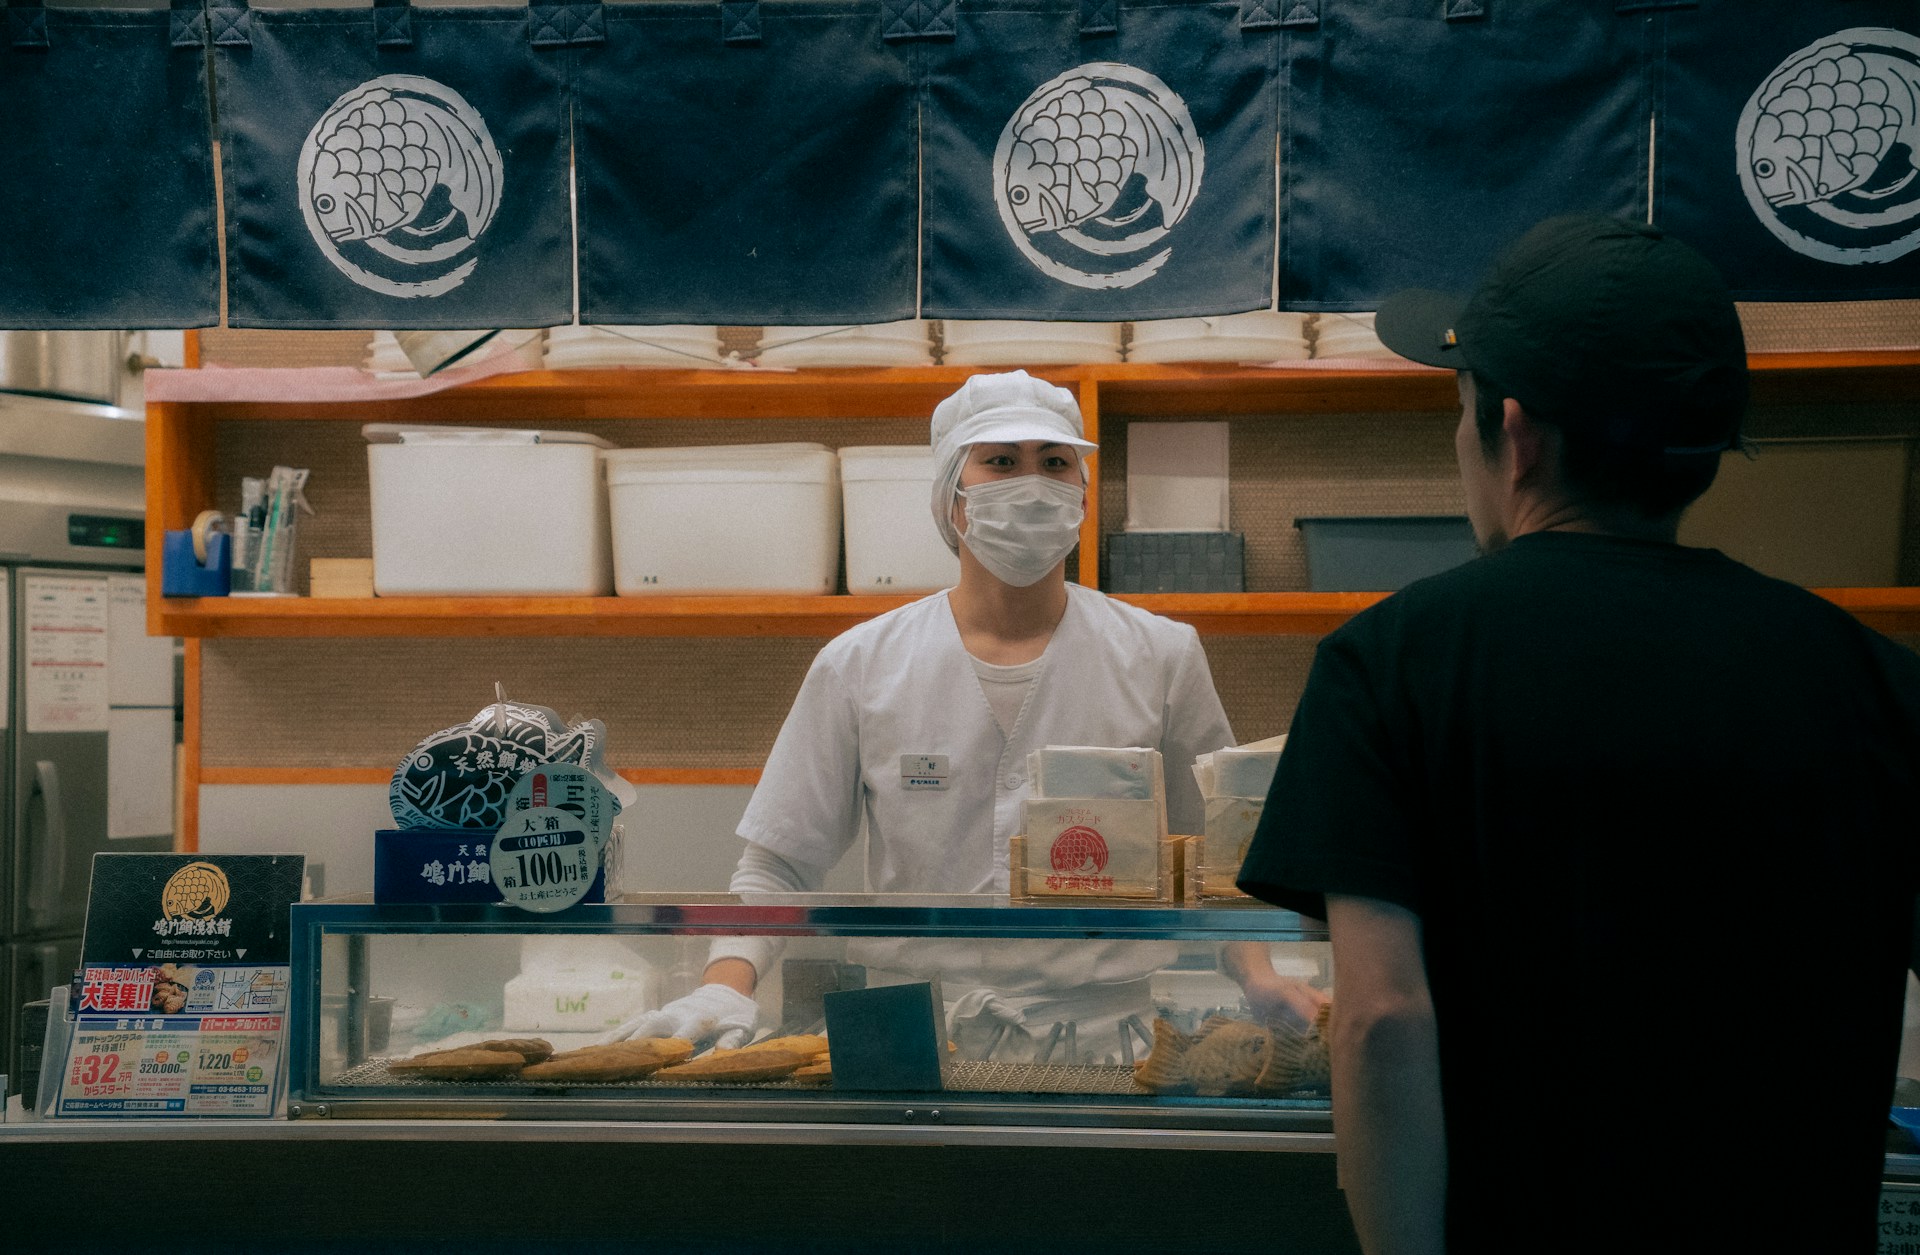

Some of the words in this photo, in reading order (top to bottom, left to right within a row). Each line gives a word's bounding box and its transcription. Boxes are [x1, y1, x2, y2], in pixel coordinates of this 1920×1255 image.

[523, 816, 560, 833] 大箱
[1057, 816, 1101, 824] カスタード
[457, 844, 487, 857] 天然
[420, 860, 490, 886] 鳴門鯛
[520, 887, 578, 900] お土産にどうぞ
[146, 949, 231, 959] ご自由にお取り下さい
[81, 1053, 120, 1085] 32
[140, 1063, 180, 1074] 320,000
[83, 1083, 130, 1097] からスタート
